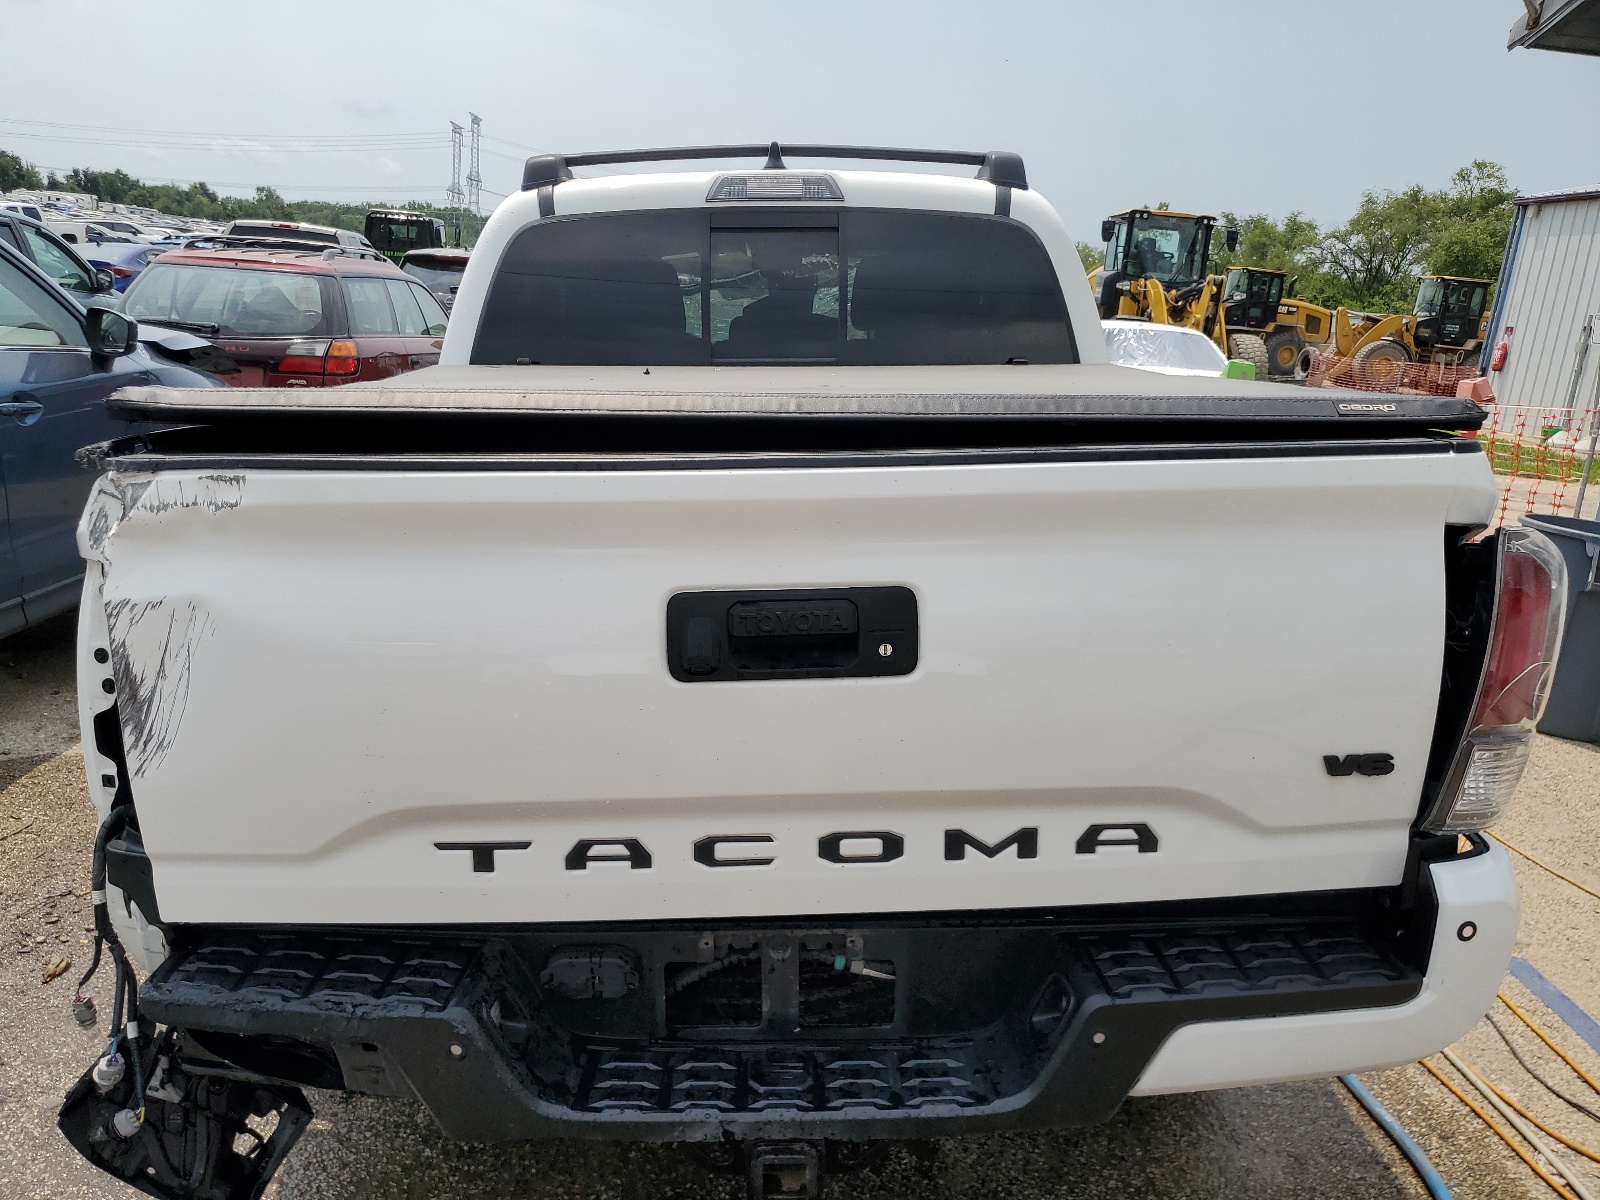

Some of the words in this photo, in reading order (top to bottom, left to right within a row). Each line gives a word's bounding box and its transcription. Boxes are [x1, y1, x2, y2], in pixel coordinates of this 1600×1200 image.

[739, 610, 849, 635] TOYOTA
[1323, 752, 1395, 777] V6
[433, 822, 1159, 873] TACOMA
